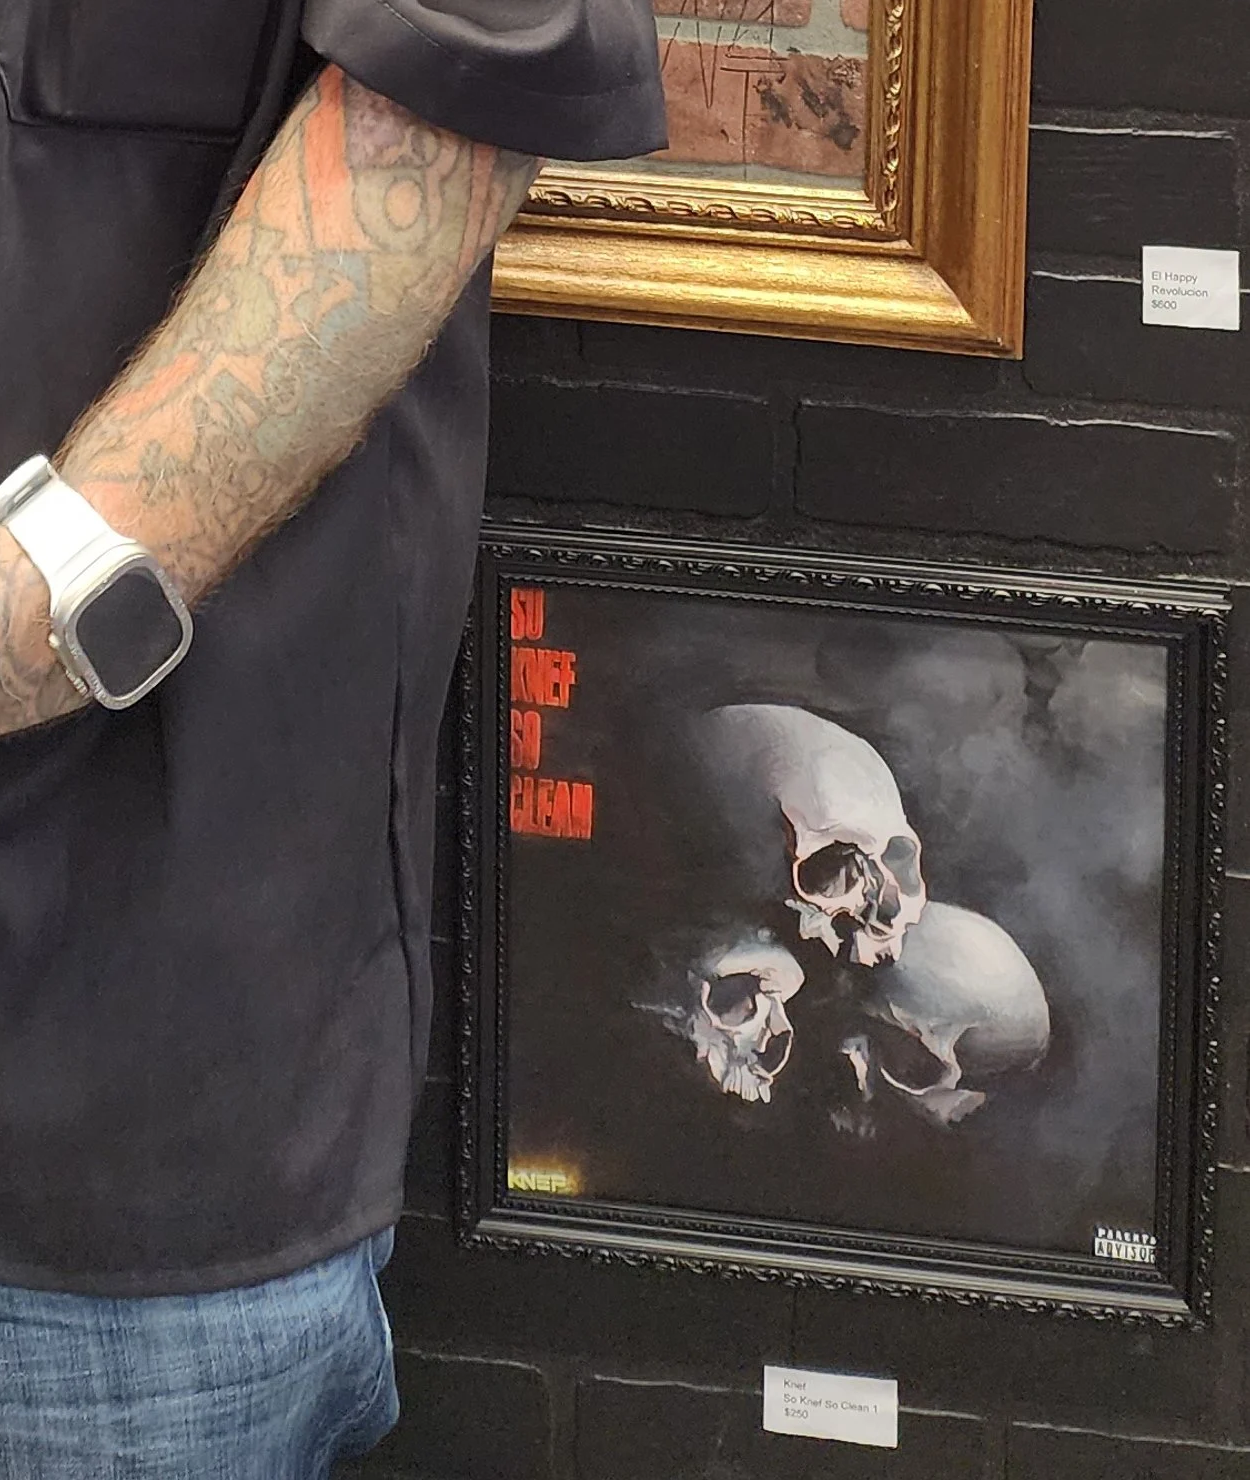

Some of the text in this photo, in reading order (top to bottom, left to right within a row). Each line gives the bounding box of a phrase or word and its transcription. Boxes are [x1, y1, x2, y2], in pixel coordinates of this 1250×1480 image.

[1164, 271, 1198, 285] Happy
[510, 646, 577, 709] KNEF
[510, 774, 594, 841] CLEAN
[783, 1379, 806, 1390] Knef
[783, 1393, 797, 1404] So
[799, 1395, 822, 1407] Knef
[824, 1400, 839, 1410] So
[841, 1401, 869, 1413] Clean
[784, 1408, 809, 1420] $250
